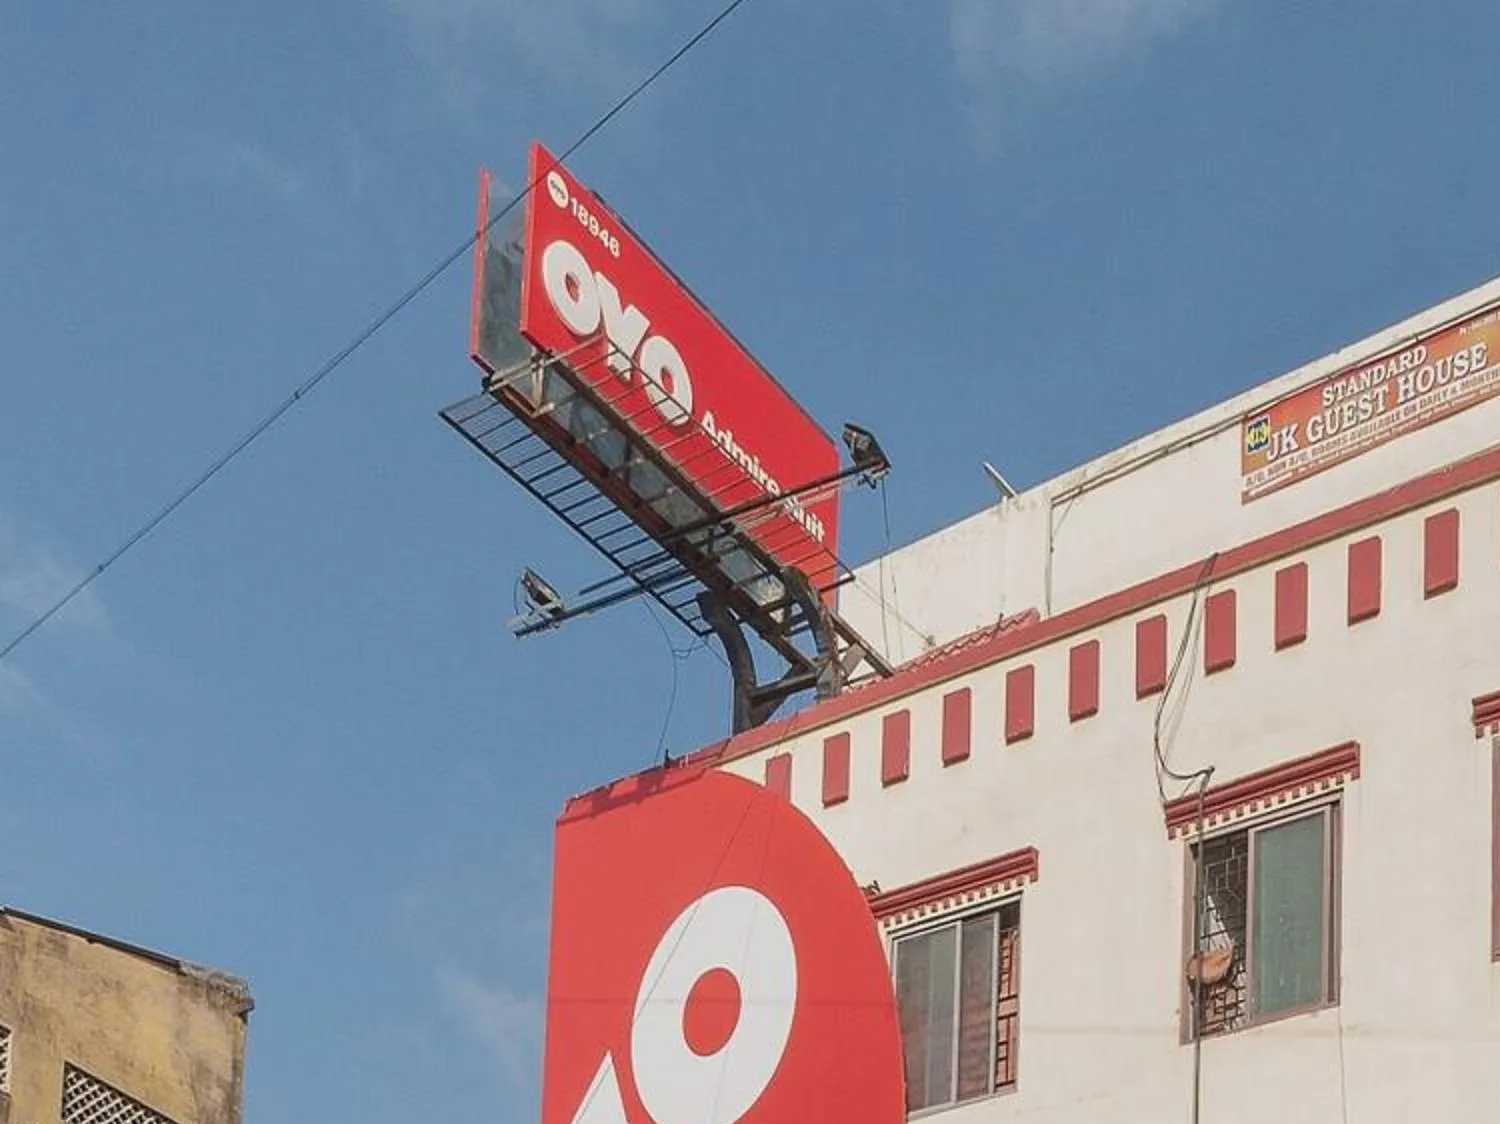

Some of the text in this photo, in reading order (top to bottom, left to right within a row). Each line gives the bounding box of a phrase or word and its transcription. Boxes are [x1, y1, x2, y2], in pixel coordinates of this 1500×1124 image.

[542, 239, 693, 427] OYO
[1323, 345, 1428, 409] STANDARD
[1267, 341, 1489, 462] JK GUEST HOUSE
[701, 410, 781, 498] Admire
